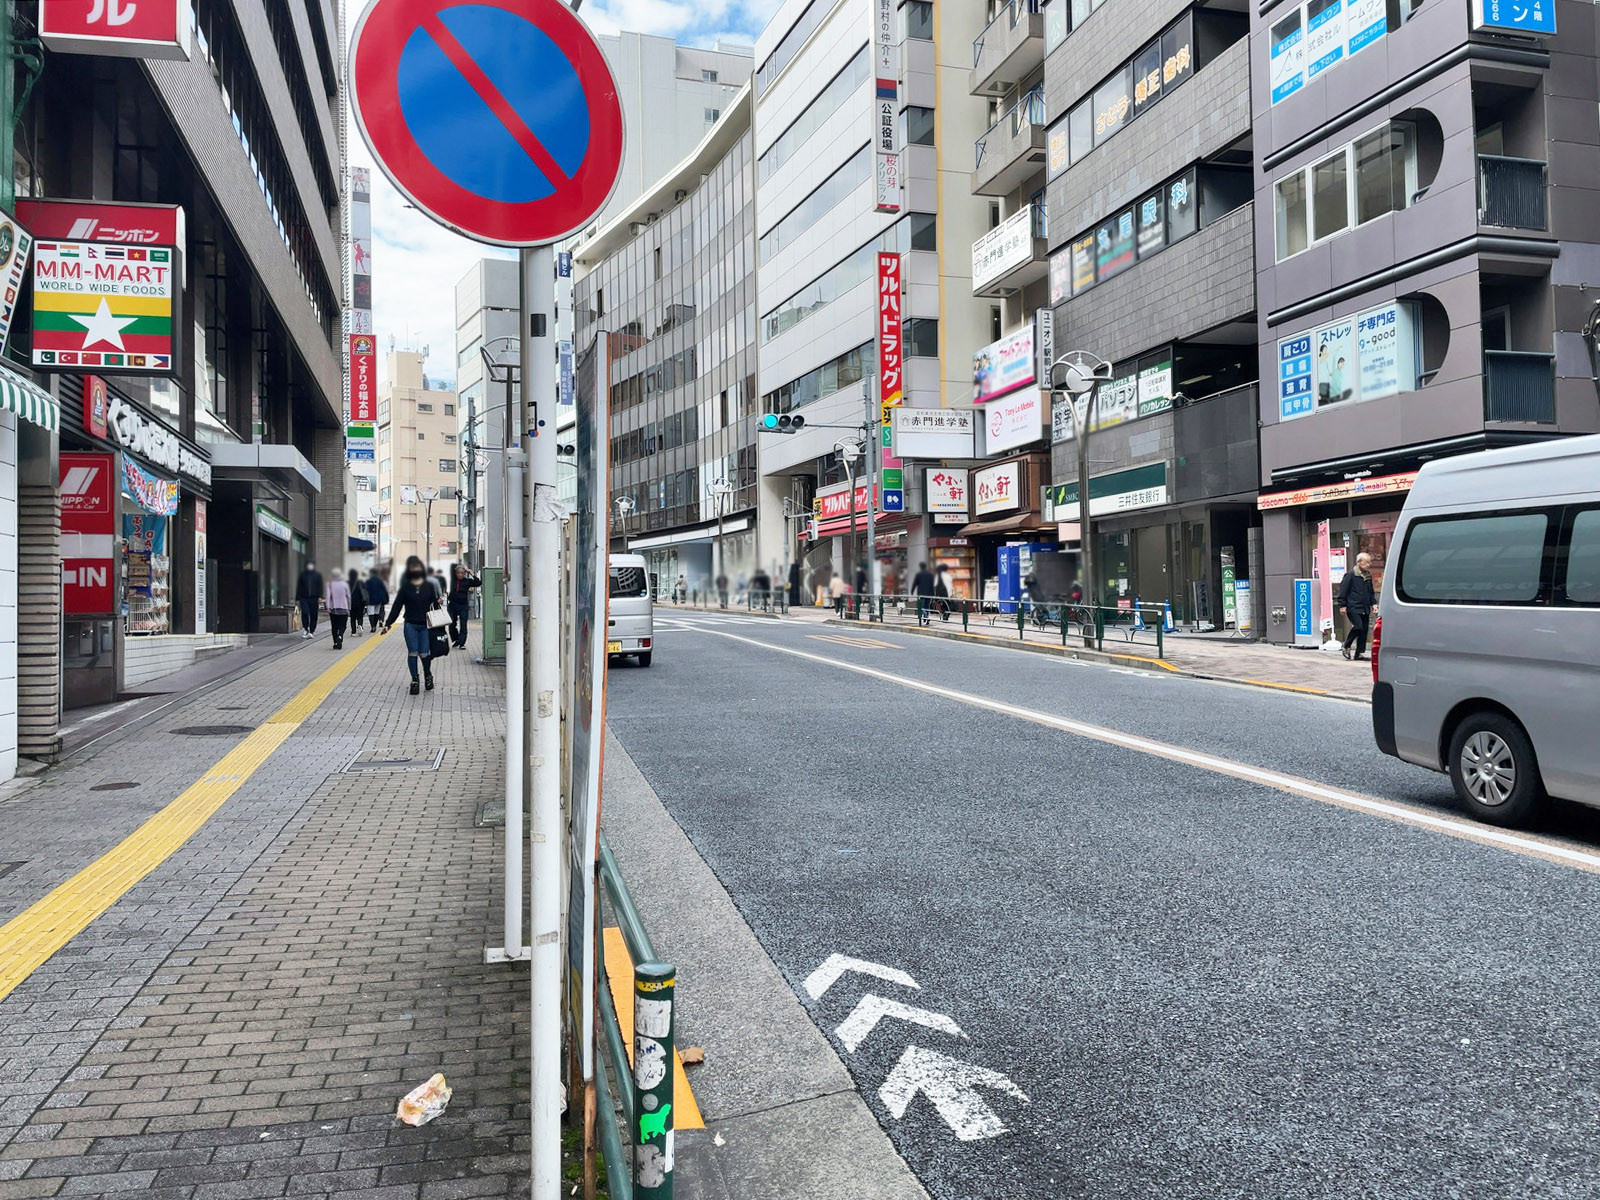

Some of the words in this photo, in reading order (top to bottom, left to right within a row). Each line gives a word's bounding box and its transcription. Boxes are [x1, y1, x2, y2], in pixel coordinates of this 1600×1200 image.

[881, 103, 893, 150] 公証役場
[878, 161, 887, 203] クリニック
[97, 227, 160, 242] ニッポン
[36, 260, 168, 285] MM-MART
[40, 280, 84, 292] WORLD
[89, 282, 119, 293] WIDE
[123, 284, 167, 296] FOODS
[880, 257, 901, 389] ツルハドラッグ
[1043, 312, 1052, 385] ユニオン駅前ビル
[1283, 340, 1308, 358] 肩こり
[357, 356, 369, 419] くすりの福太郎
[1100, 385, 1137, 411] パソコン
[911, 416, 969, 428] 赤門進学塾
[932, 472, 963, 487] やよい
[978, 475, 1011, 502] やよい軒
[824, 487, 868, 514] ツルハドッグ
[1118, 489, 1160, 508] 三井住友銀行
[1261, 497, 1289, 508] docomo
[1223, 569, 1235, 606] 公務員
[1299, 582, 1308, 632] BIGLOBE
